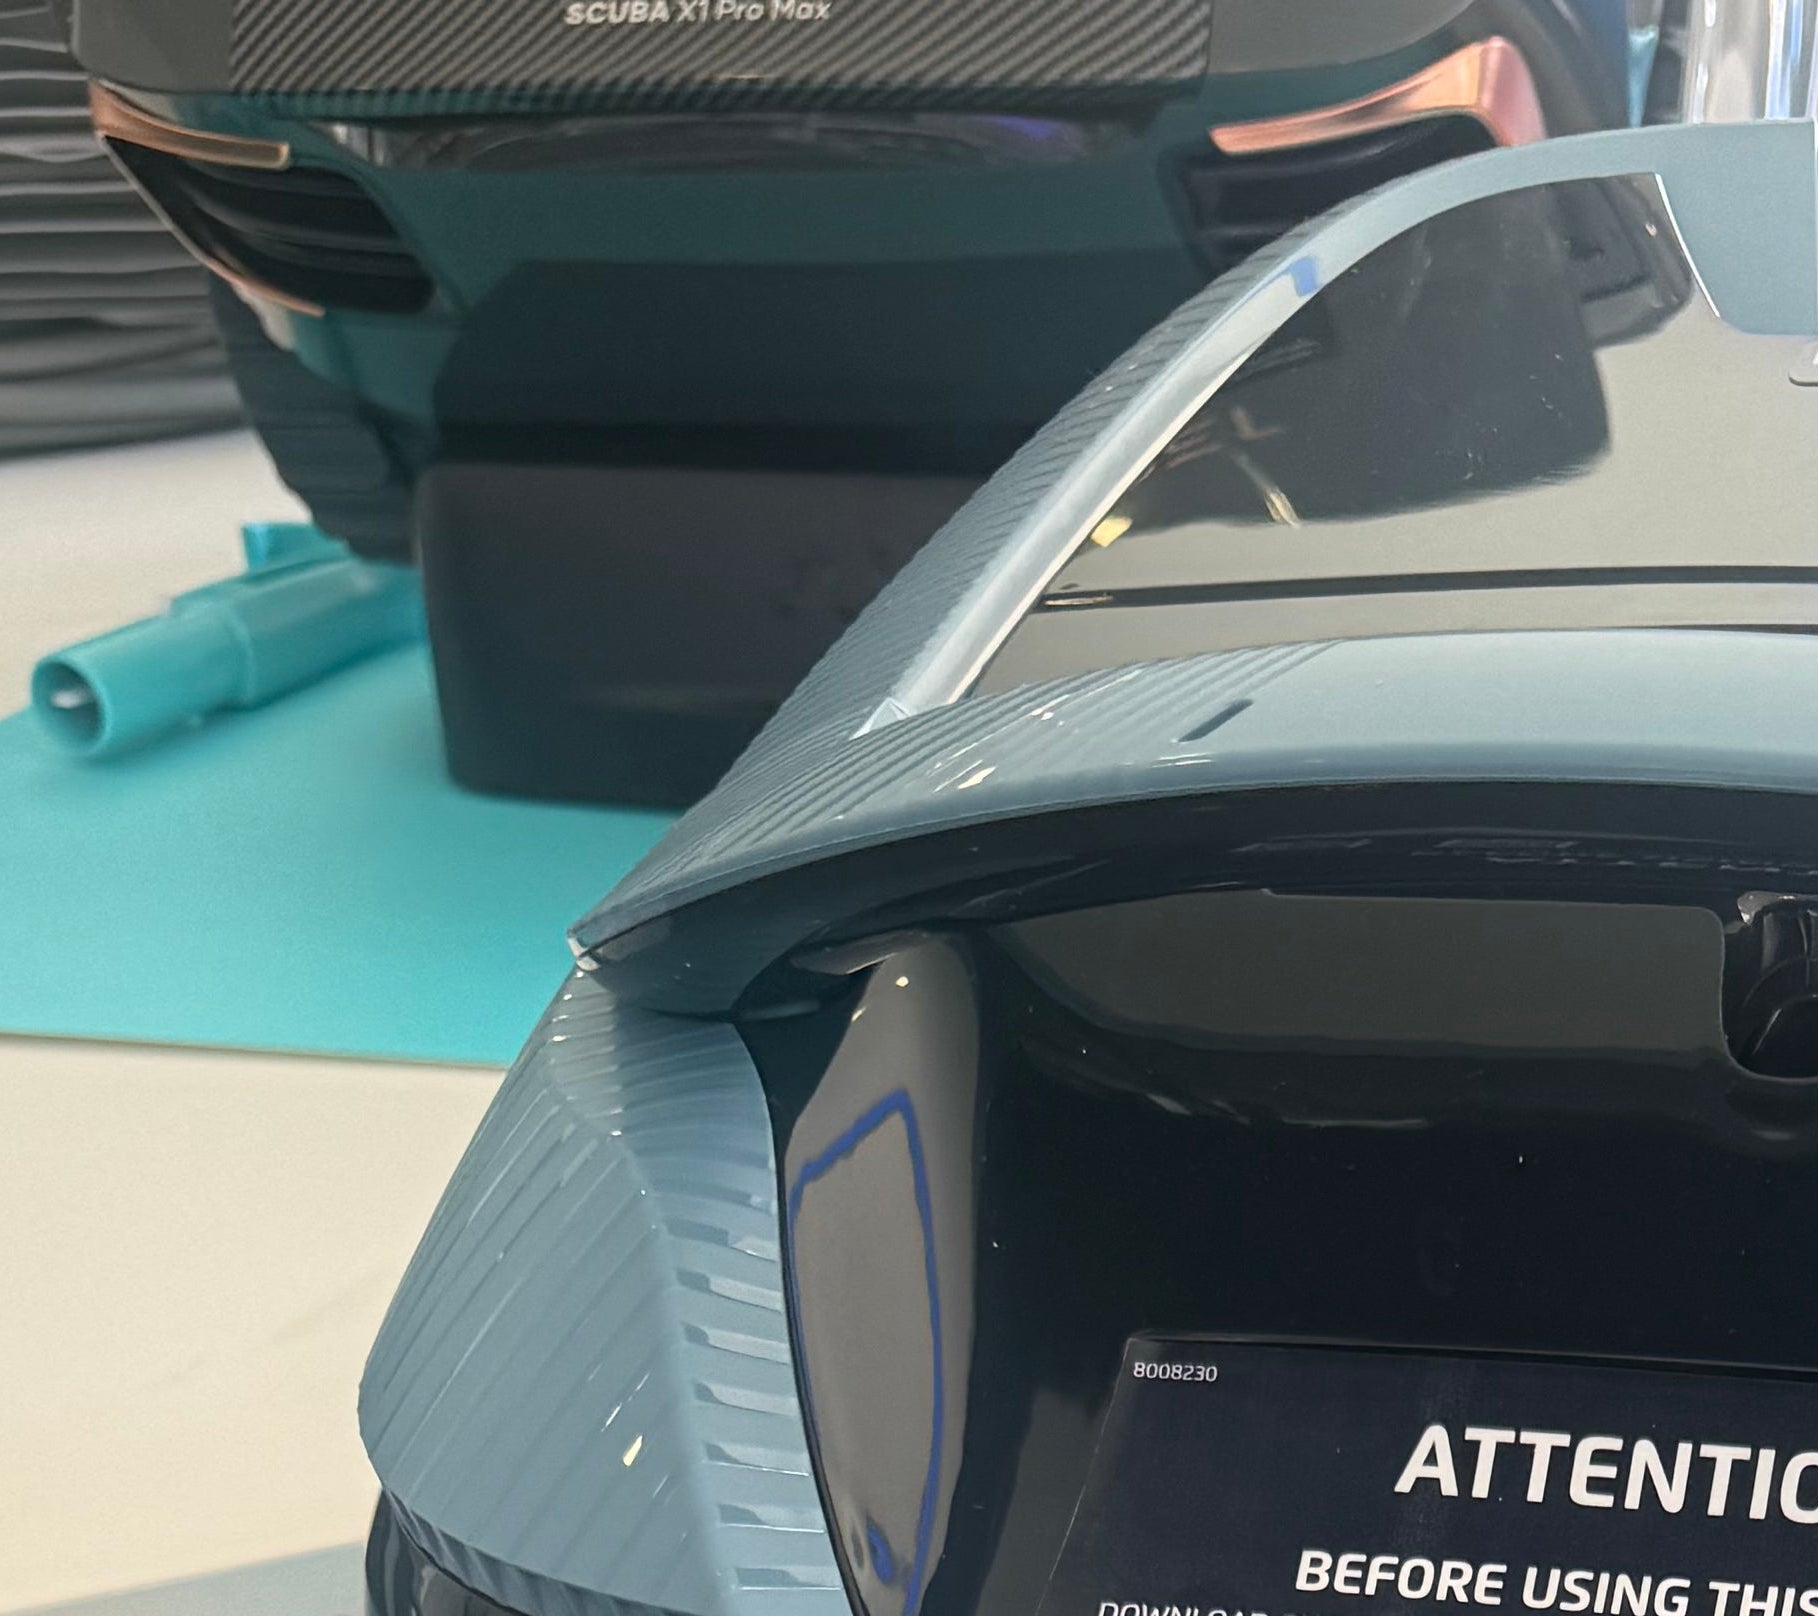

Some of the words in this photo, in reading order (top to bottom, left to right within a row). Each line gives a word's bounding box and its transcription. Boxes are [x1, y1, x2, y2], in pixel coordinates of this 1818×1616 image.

[565, 0, 670, 25] SCUBA
[676, 0, 709, 22] X1
[714, 0, 765, 21] Pro
[770, 0, 832, 20] Max
[1133, 1361, 1218, 1382] 8008230
[1296, 1549, 1507, 1606] BEFORE
